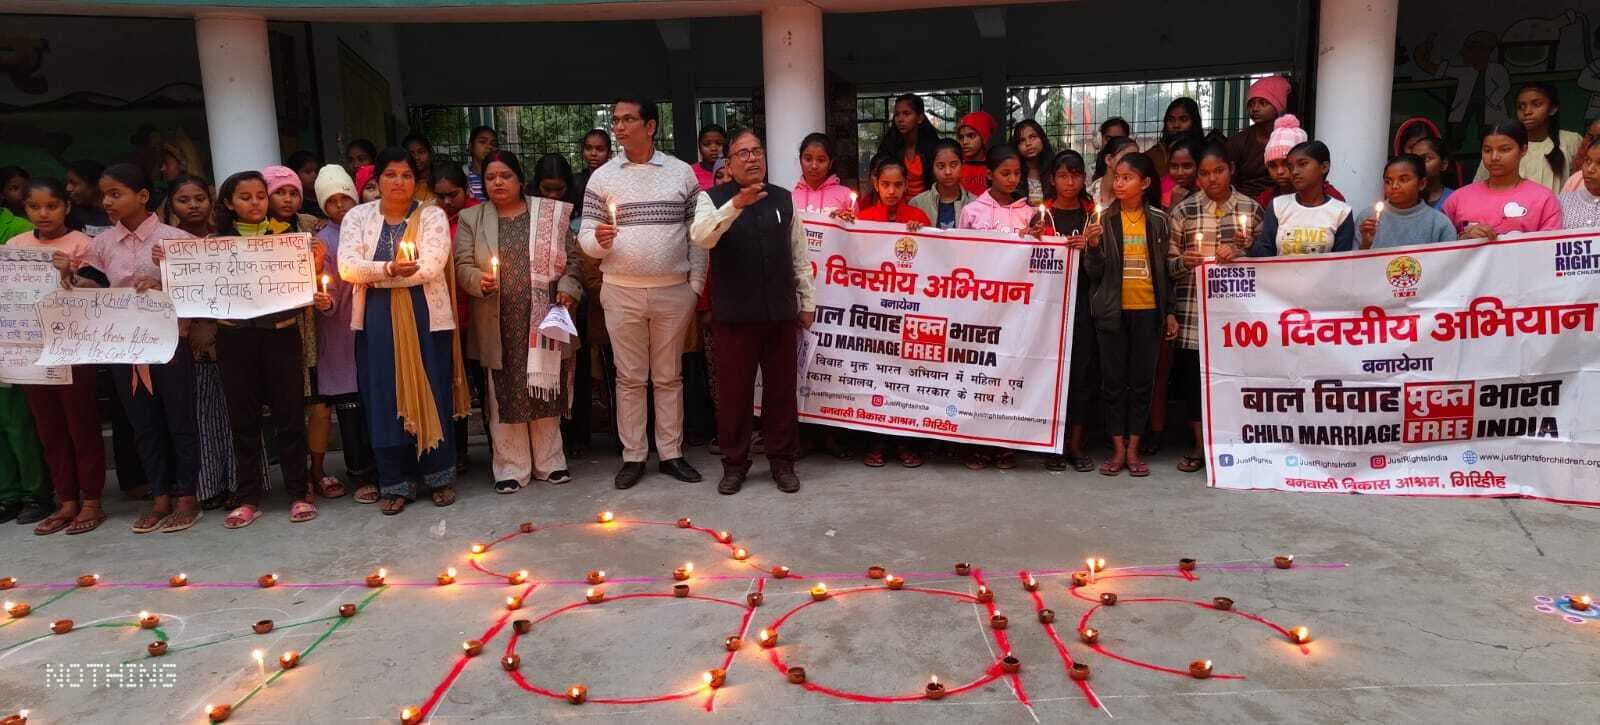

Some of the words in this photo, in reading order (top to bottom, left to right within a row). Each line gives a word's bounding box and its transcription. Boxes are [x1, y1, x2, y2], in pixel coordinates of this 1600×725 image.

[1031, 248, 1055, 259] JUST
[1555, 240, 1592, 256] JUST
[1029, 259, 1064, 271] RIGHTS
[1555, 254, 1600, 272] RIGHT
[825, 255, 919, 295] दिवसीय
[923, 267, 1035, 305] अभियान
[880, 297, 920, 312] बनायेगा
[814, 305, 845, 326] ाल
[849, 304, 902, 333] विवाह
[904, 317, 946, 340] मुक्त
[950, 322, 1002, 345] भारत
[1221, 320, 1268, 348] 100
[1278, 305, 1421, 347] दिवसीय
[1431, 296, 1599, 342] अभियान
[835, 334, 900, 356] MARRIAGE
[904, 342, 942, 360] FREE
[947, 347, 997, 367] INDIA
[816, 353, 844, 369] विवाह
[850, 360, 869, 373] मुक्त
[876, 363, 902, 376] भारत
[908, 365, 948, 381] अभियान
[956, 370, 965, 383] में
[971, 372, 1000, 387] महिला
[1008, 377, 1024, 390] एवं
[1362, 352, 1434, 373] बनायेगा
[884, 382, 910, 393] भारत
[916, 384, 951, 399] सरकार
[957, 387, 967, 400] के
[974, 391, 994, 403] साथ
[1241, 387, 1305, 413] बाल
[1312, 379, 1402, 413] विवाह
[1407, 385, 1473, 417] मुक्त
[1480, 380, 1563, 409] भारत
[856, 408, 886, 423] विकास
[1242, 424, 1294, 444] CHILD
[1300, 424, 1402, 446] MARRIAGE
[1407, 419, 1469, 441] FREE
[1477, 417, 1559, 438] INDIA
[1341, 477, 1391, 491] विकास
[1450, 470, 1507, 489] गिरिडीह
